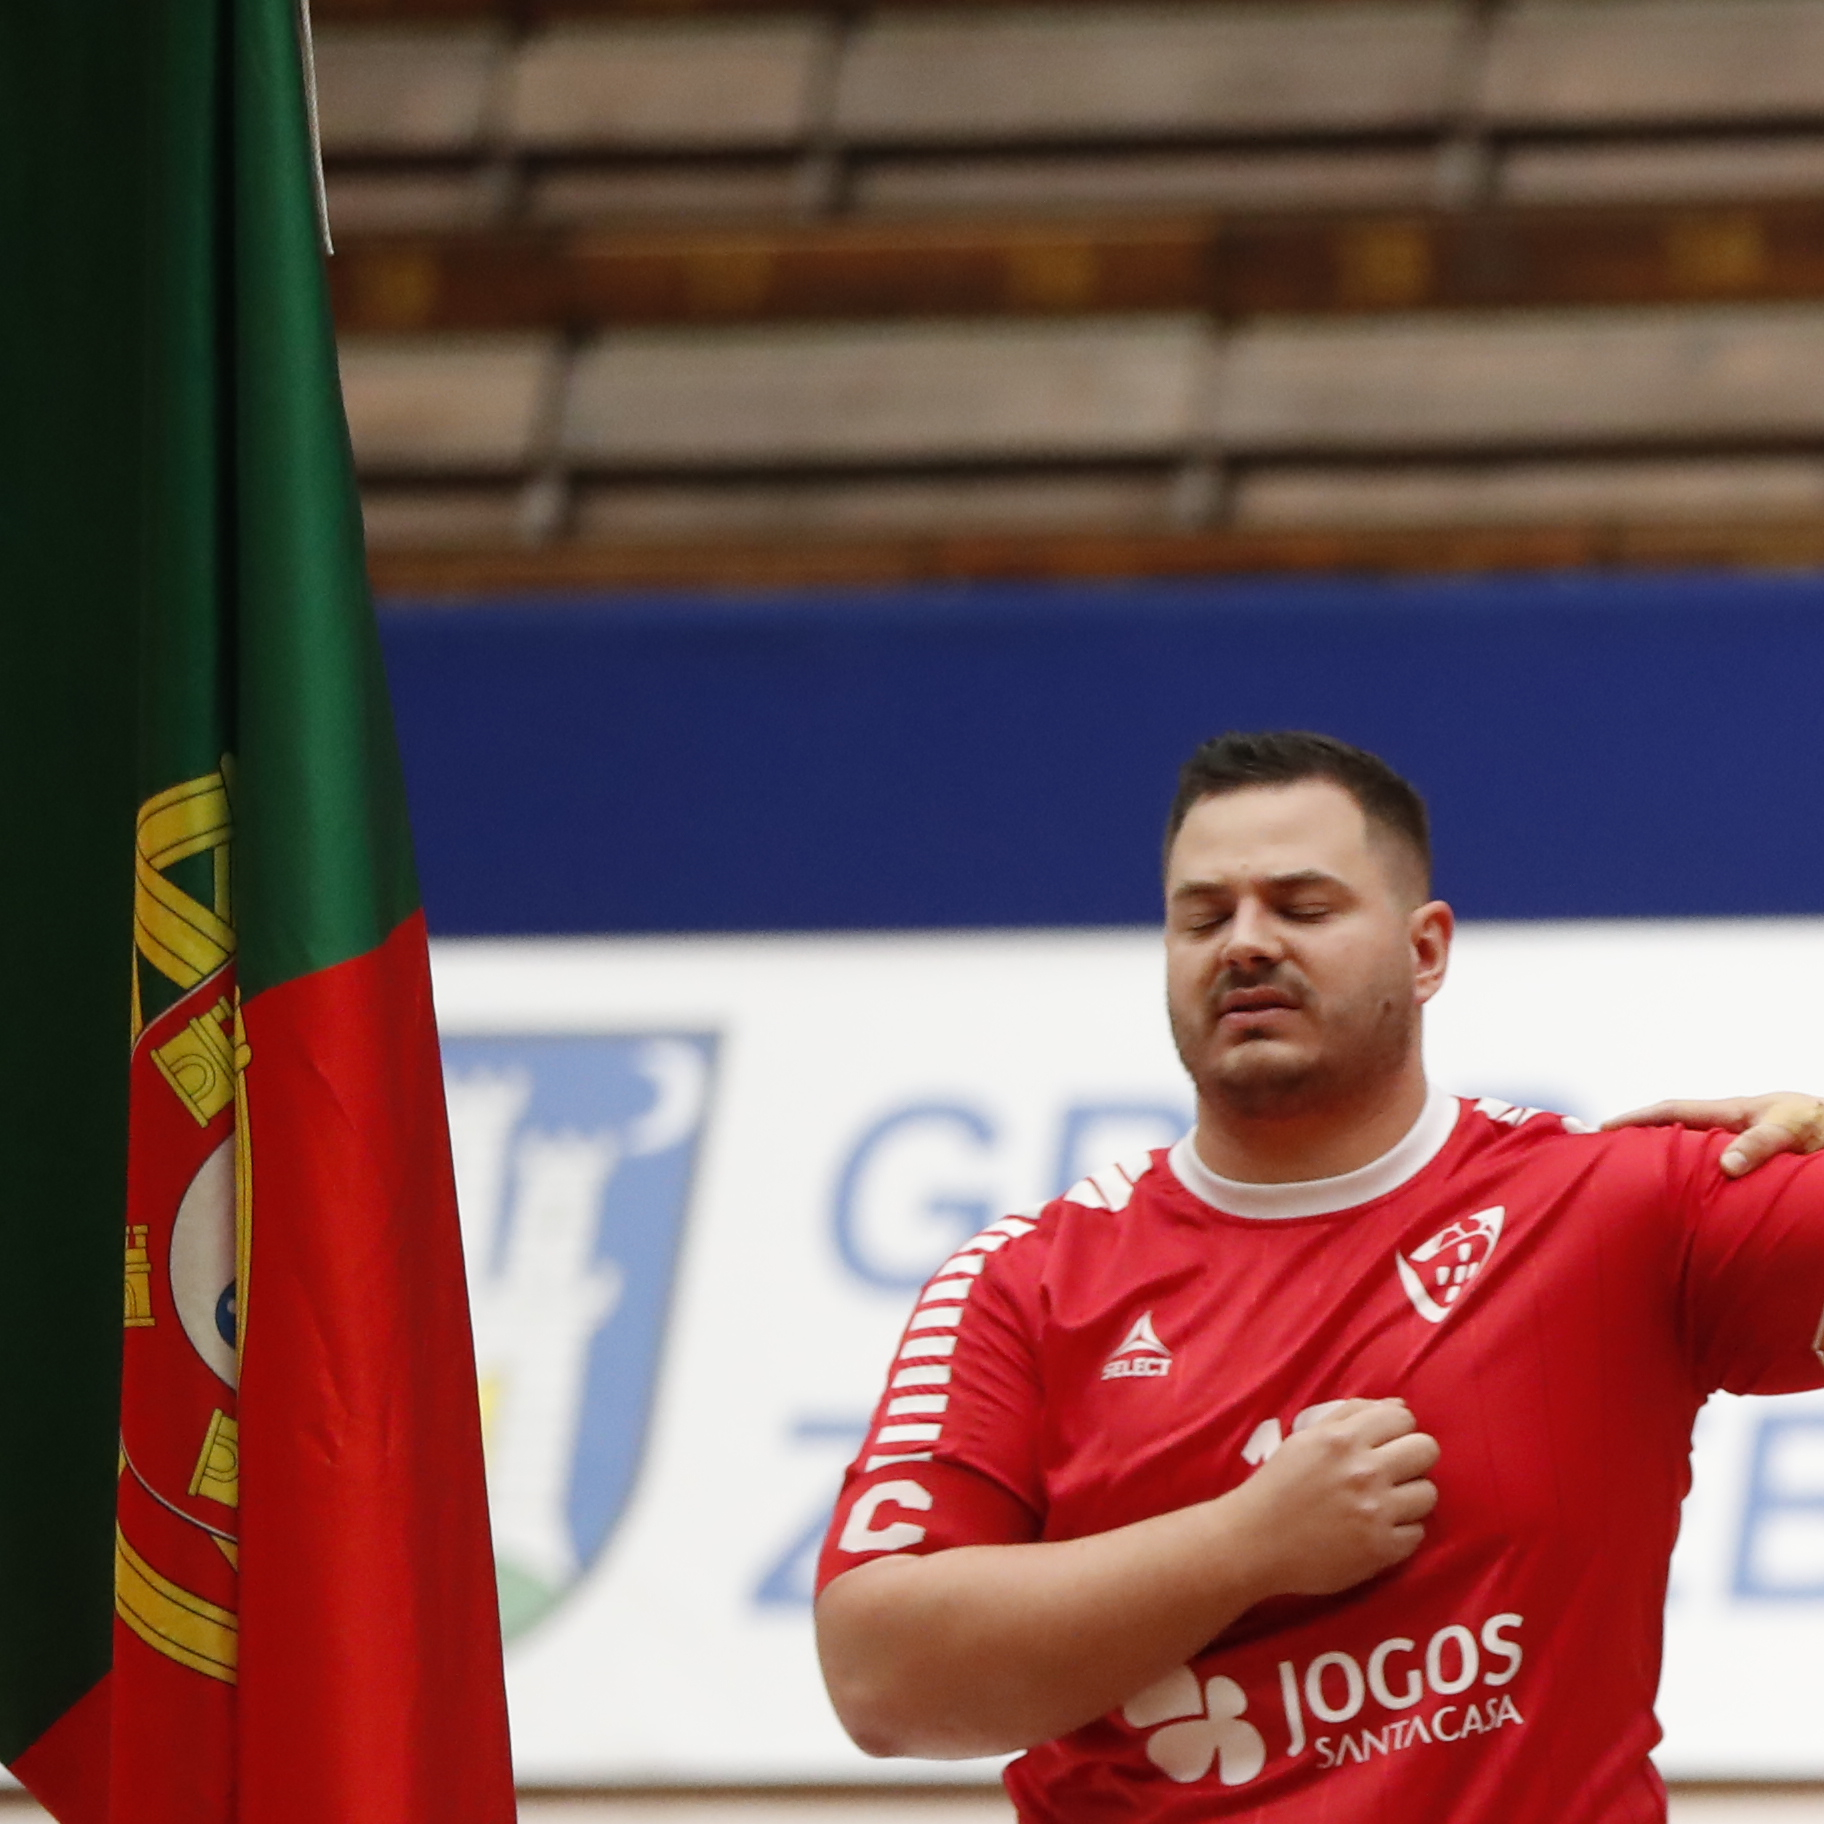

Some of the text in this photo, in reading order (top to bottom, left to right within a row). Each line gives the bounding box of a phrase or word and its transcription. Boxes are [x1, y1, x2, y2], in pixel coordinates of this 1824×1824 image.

[1100, 1357, 1172, 1381] SELECT
[838, 1479, 933, 1554] C
[1278, 1612, 1524, 1757] JOGOS
